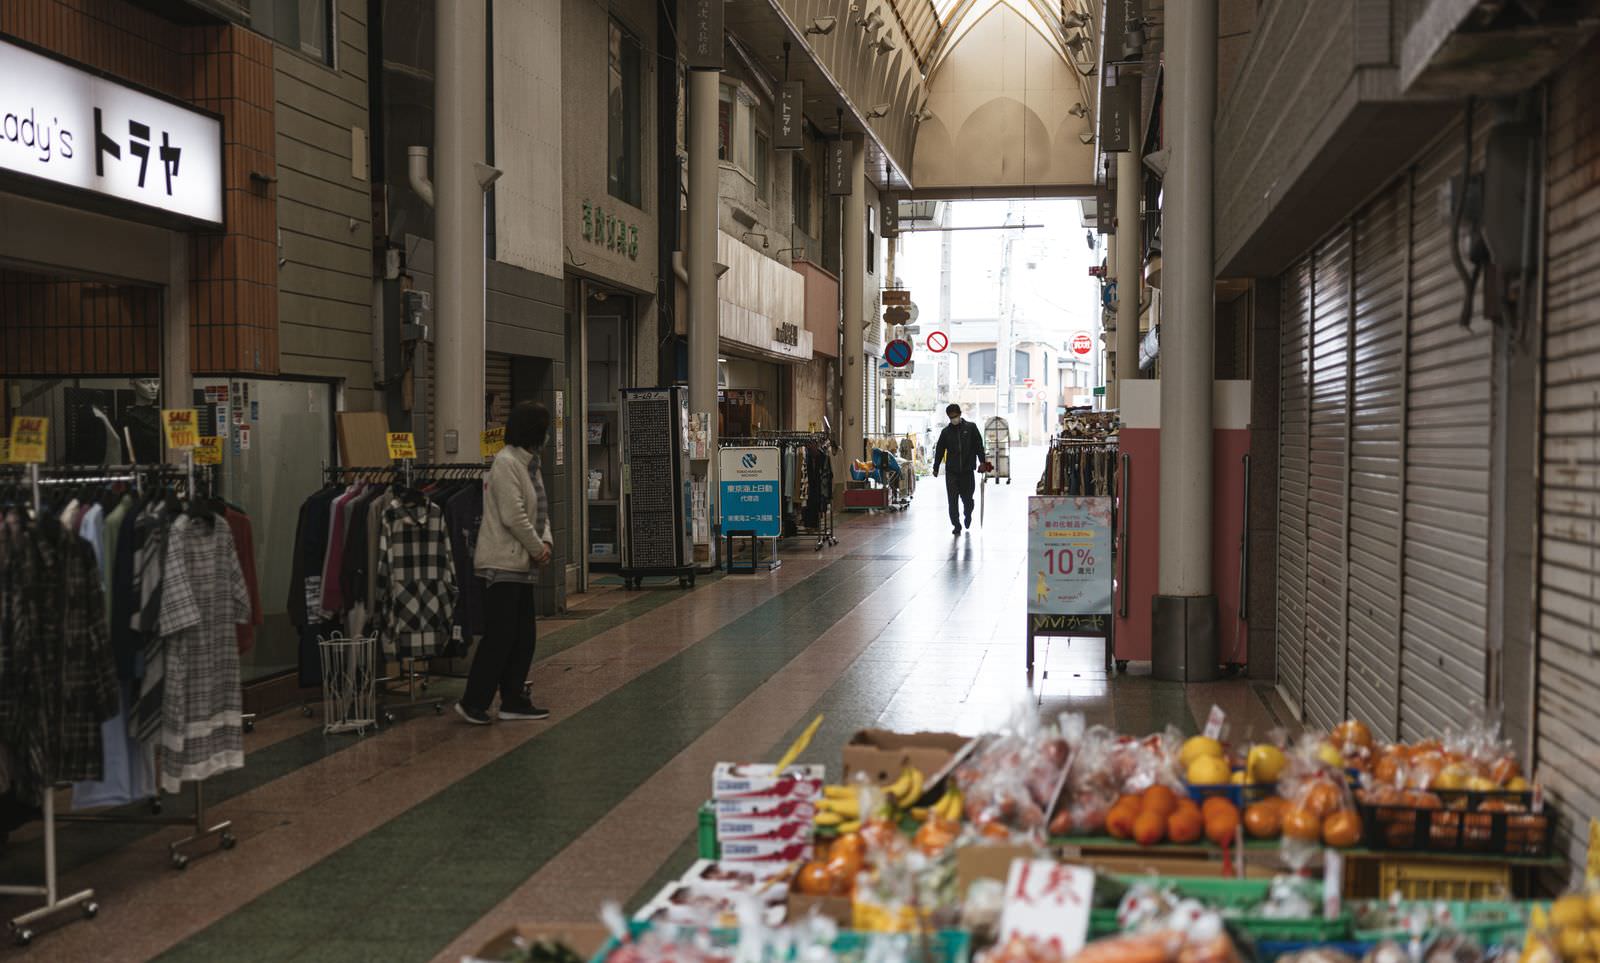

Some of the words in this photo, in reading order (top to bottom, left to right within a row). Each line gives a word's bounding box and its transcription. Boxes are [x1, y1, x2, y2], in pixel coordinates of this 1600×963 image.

[0, 107, 73, 163] ady's
[782, 103, 792, 136] トラヤ
[93, 106, 182, 196] トラヤ
[168, 411, 191, 422] SALE
[1044, 549, 1095, 575] 10%
